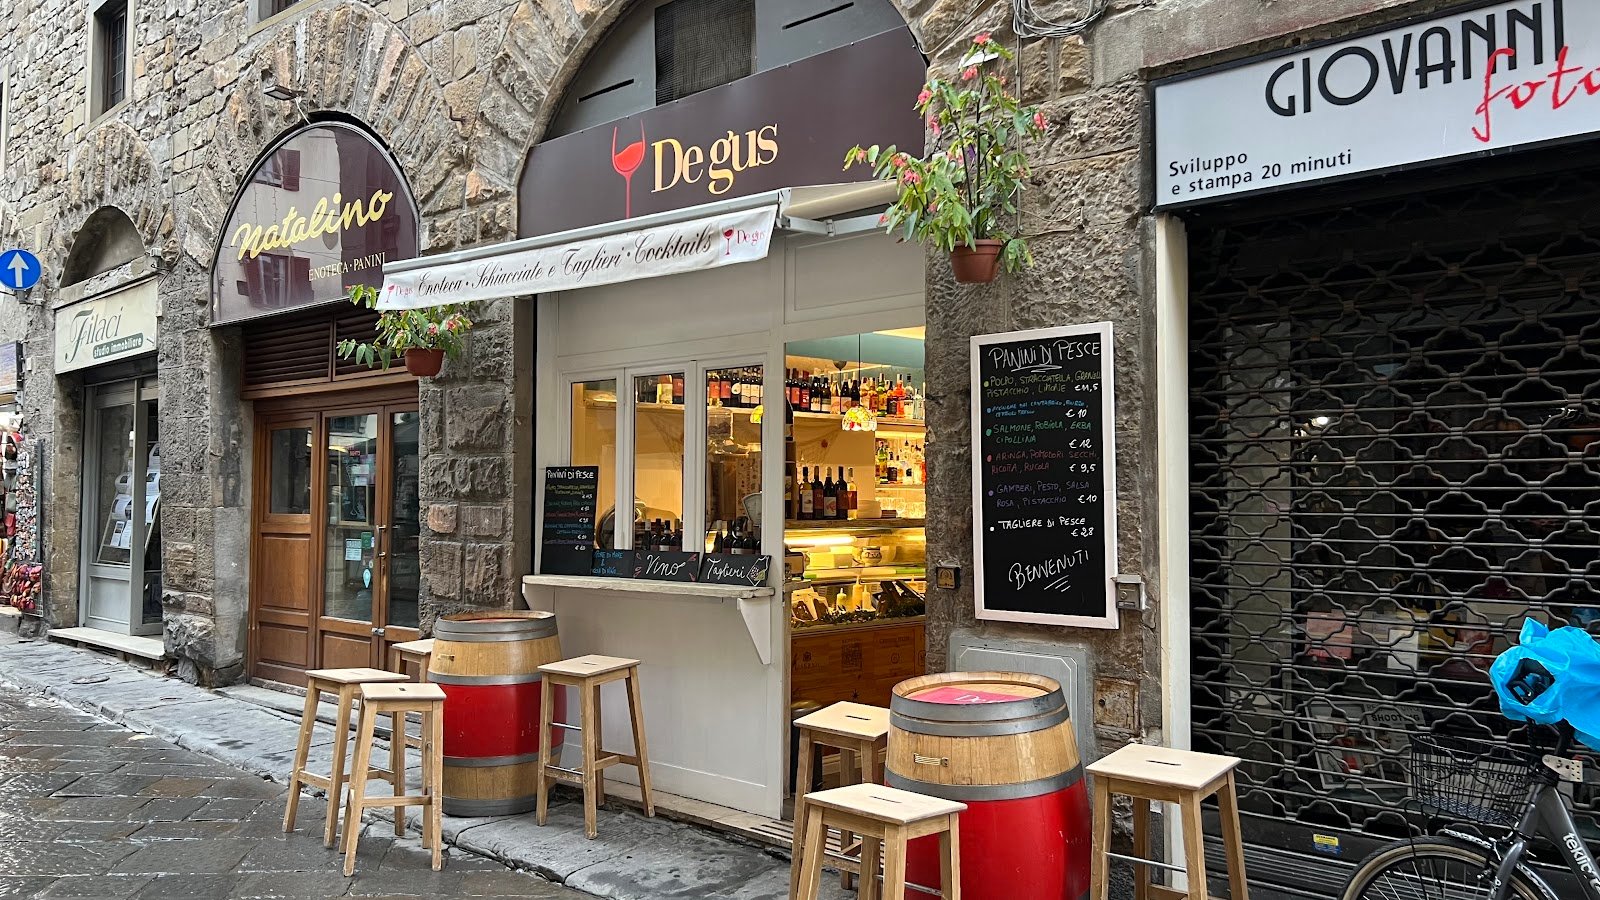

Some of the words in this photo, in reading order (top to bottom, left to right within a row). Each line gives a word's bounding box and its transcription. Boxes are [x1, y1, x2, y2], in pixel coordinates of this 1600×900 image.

[1265, 0, 1564, 117] GIOVANNI
[1169, 152, 1248, 177] Sviluppo
[1171, 184, 1181, 196] e
[1189, 171, 1252, 193] stampa
[1261, 163, 1281, 180] 20
[1290, 148, 1352, 175] minuti
[418, 271, 463, 297] Enoteca
[471, 261, 544, 290] Schiacciate
[561, 243, 624, 282] Taglieri
[634, 223, 716, 264] Cocktails
[64, 306, 124, 364] Filaci
[93, 346, 110, 358] studio
[110, 337, 142, 353] immobiliare
[1053, 340, 1100, 361] PESCE
[1070, 421, 1092, 431] ERBA
[1059, 516, 1086, 526] PESCE
[645, 554, 686, 576] Vino
[1008, 550, 1089, 591] BENVENUTI
